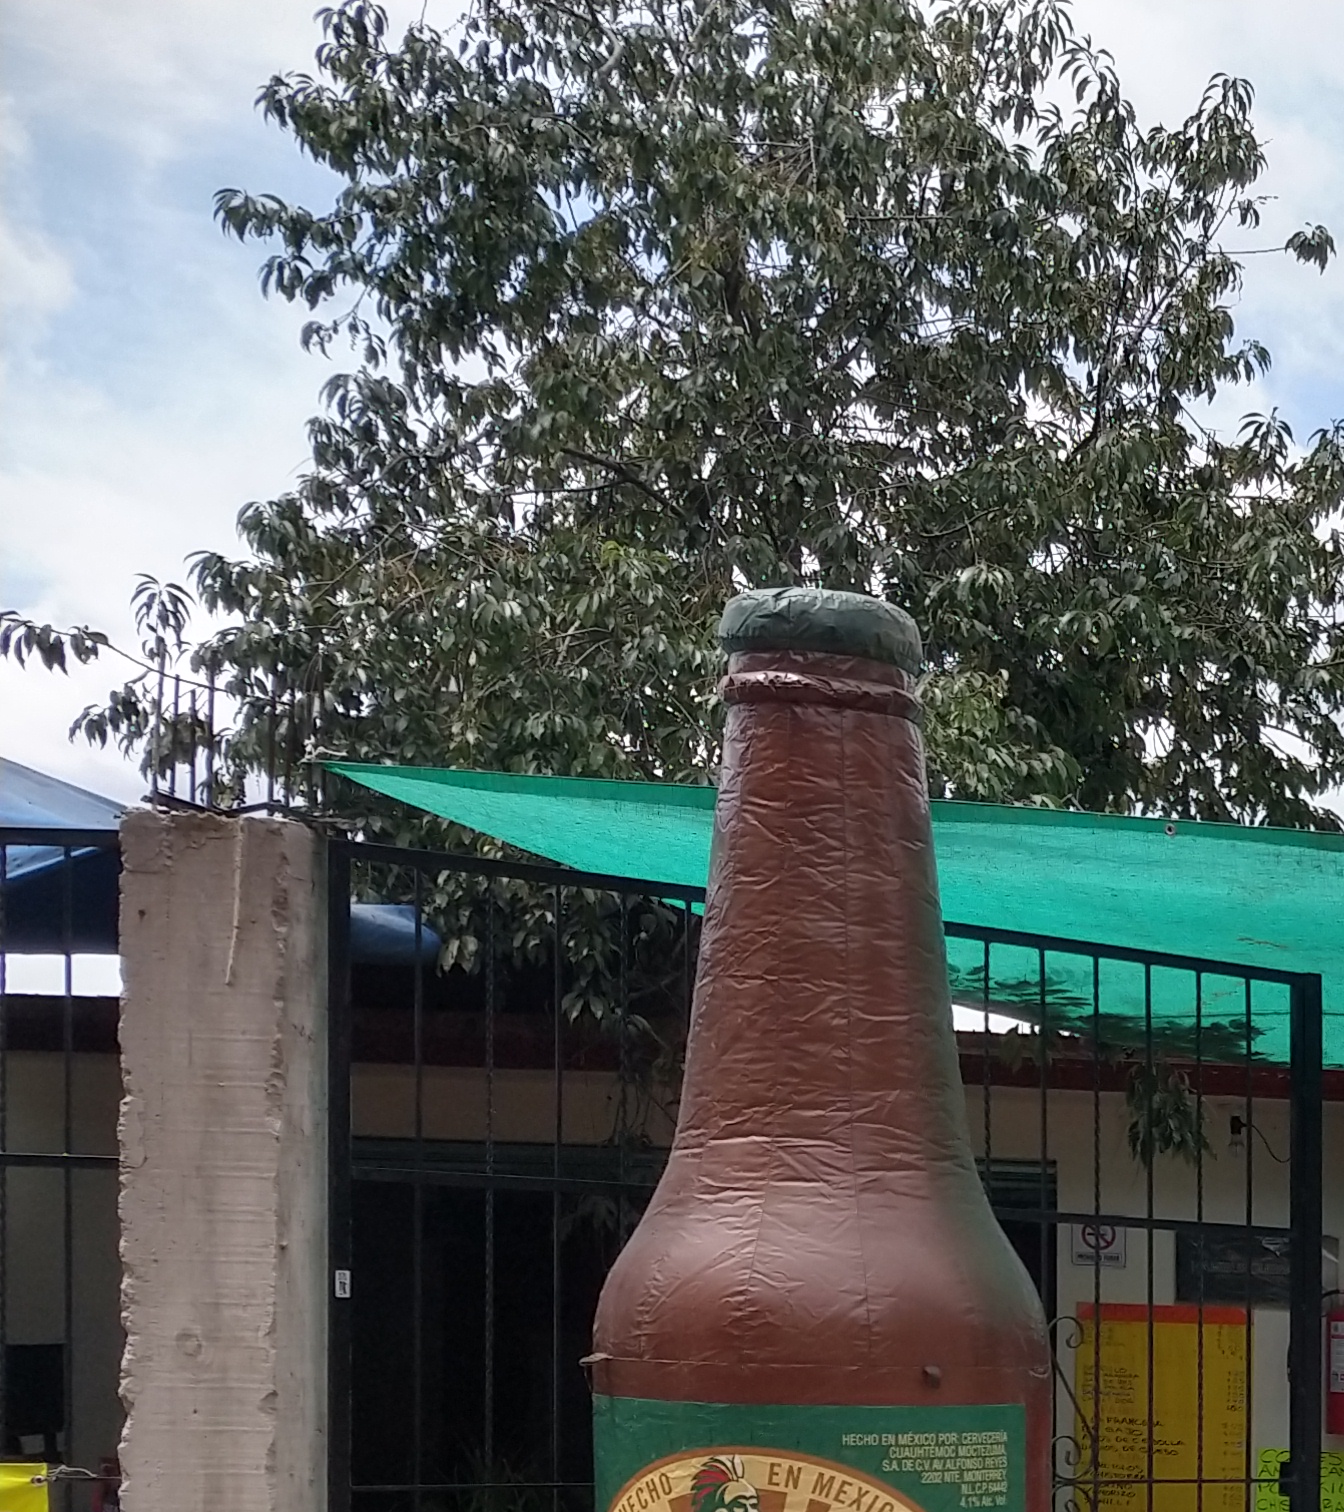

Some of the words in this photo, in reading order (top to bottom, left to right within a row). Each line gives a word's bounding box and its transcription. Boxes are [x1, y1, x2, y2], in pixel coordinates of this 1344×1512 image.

[842, 1434, 879, 1446] HECHO
[882, 1433, 896, 1445] EN
[898, 1431, 936, 1446] MÉXICO
[985, 1456, 1008, 1468] REYES
[766, 1462, 803, 1491] EN
